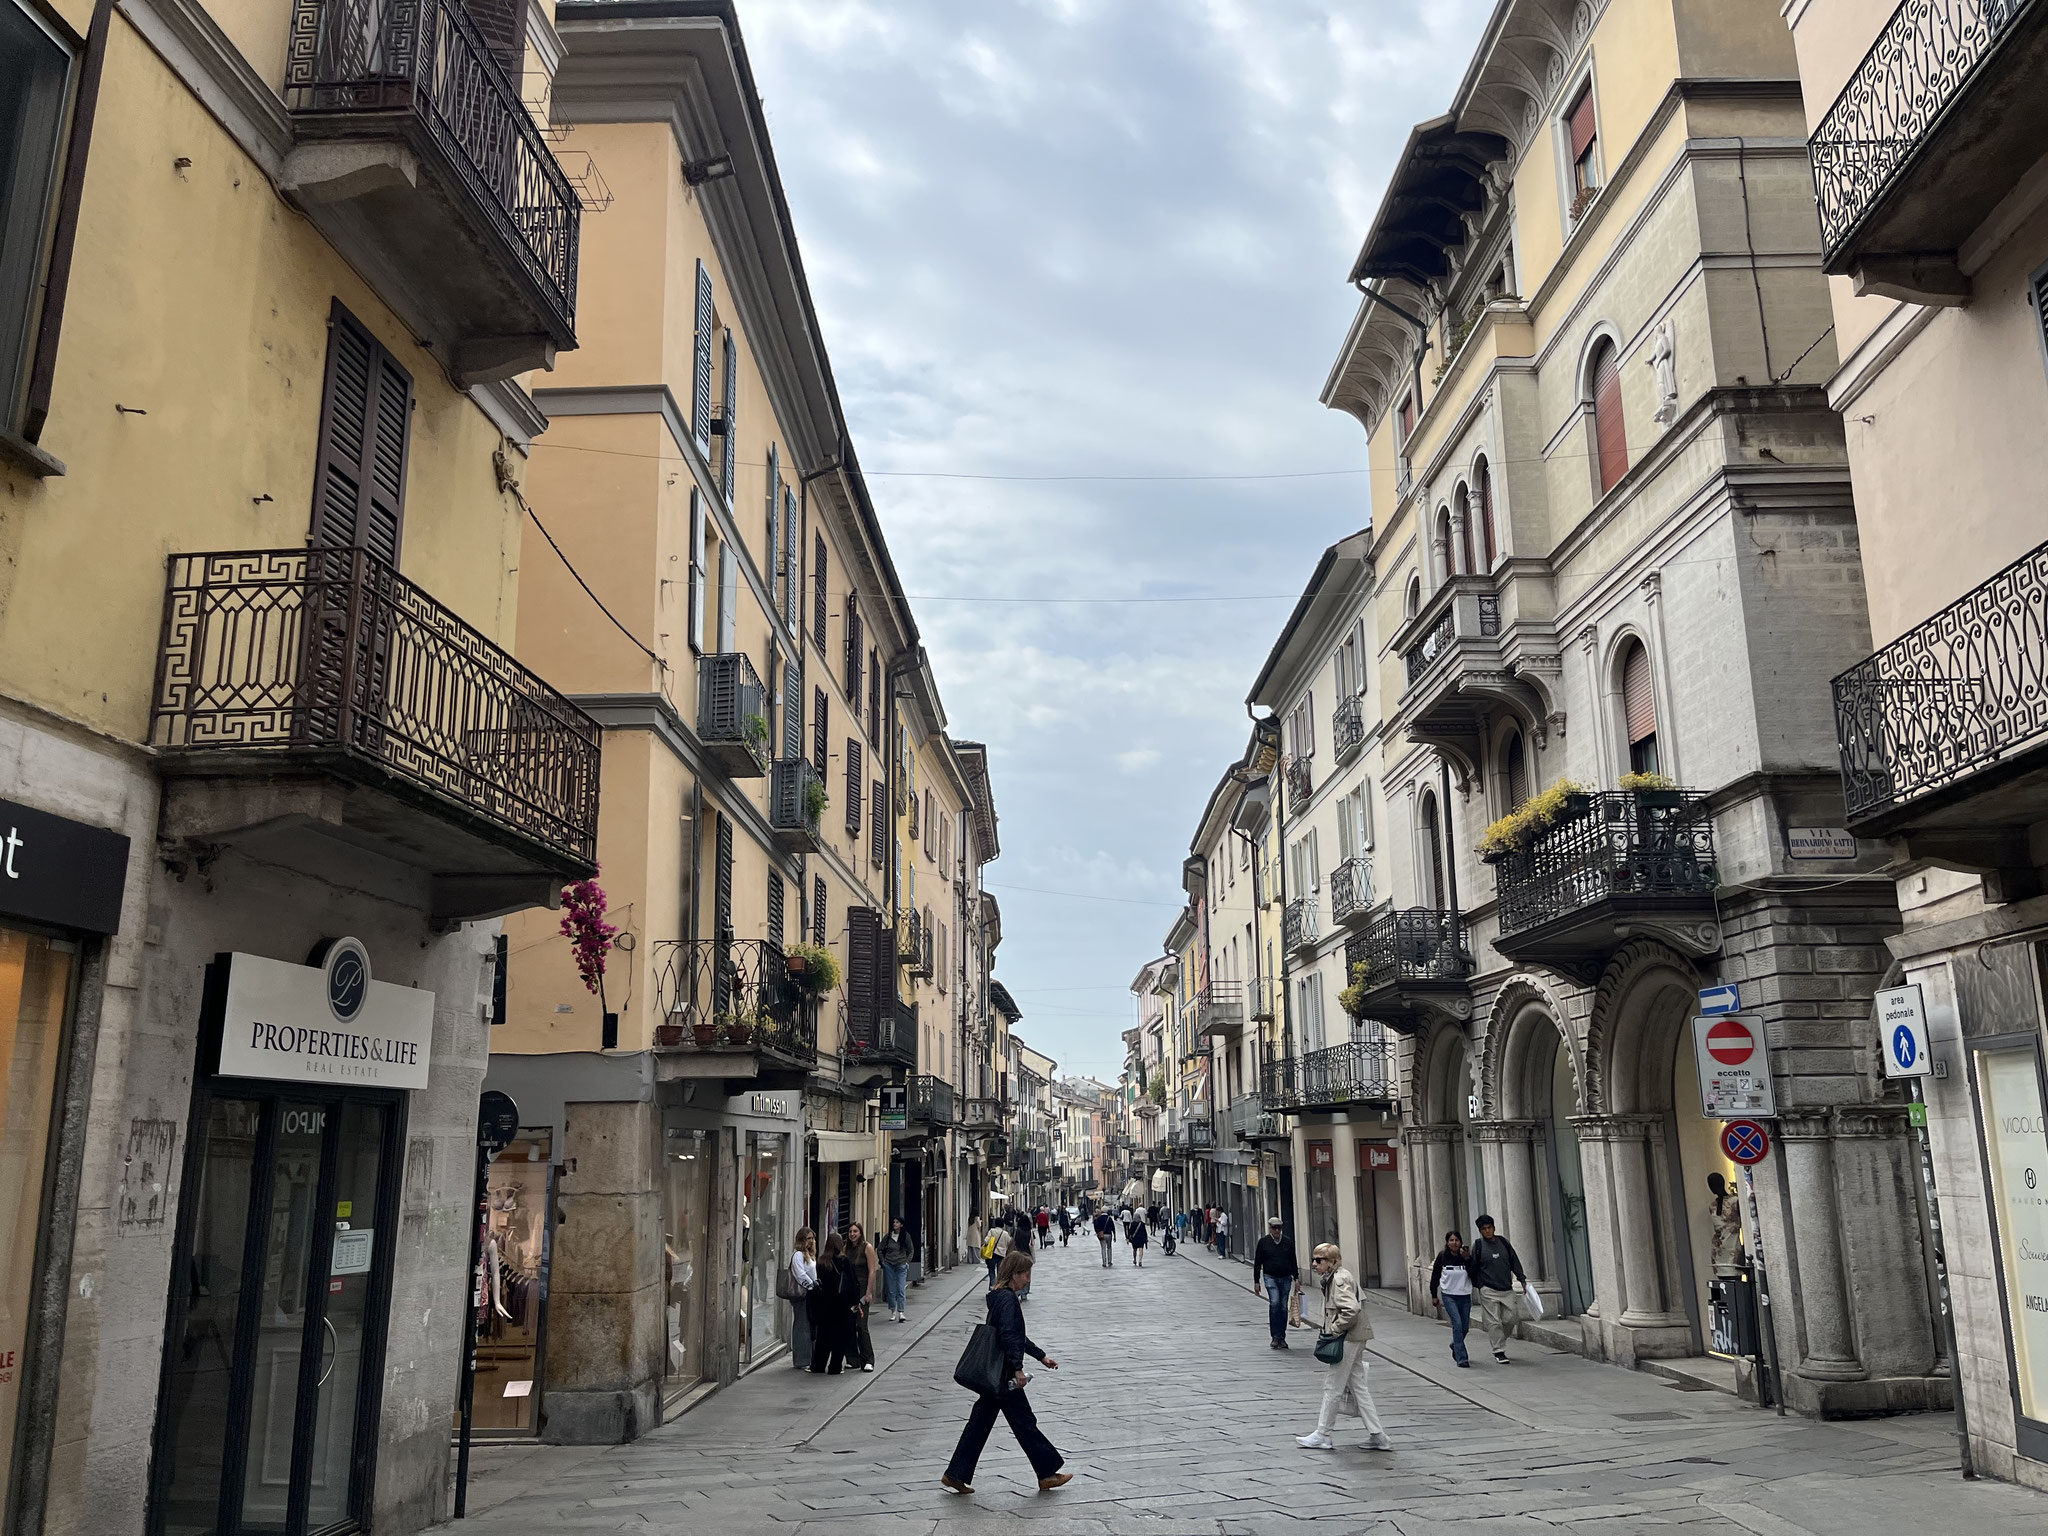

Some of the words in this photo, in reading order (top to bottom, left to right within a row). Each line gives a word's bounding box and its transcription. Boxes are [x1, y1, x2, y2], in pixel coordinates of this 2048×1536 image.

[1809, 829, 1832, 838] VIA
[1790, 838, 1833, 847] BERNARDINO
[1834, 838, 1853, 847] GATTI
[0, 827, 24, 879] t
[1890, 996, 1905, 1006] area
[1885, 1007, 1914, 1022] pedonale
[306, 1061, 333, 1074] REAL
[340, 1064, 379, 1078] ESTATE
[1717, 1069, 1751, 1077] eccetto
